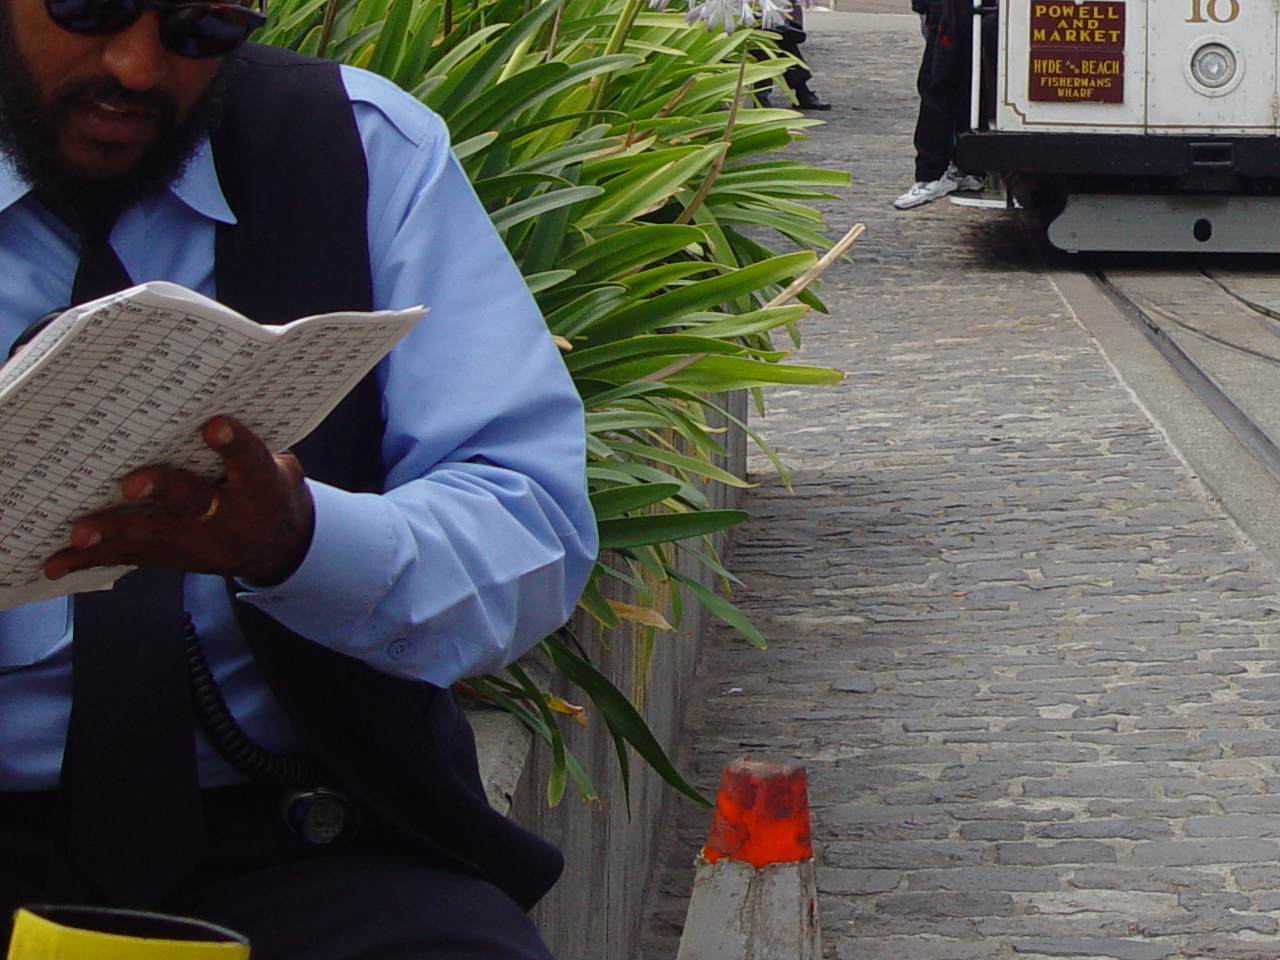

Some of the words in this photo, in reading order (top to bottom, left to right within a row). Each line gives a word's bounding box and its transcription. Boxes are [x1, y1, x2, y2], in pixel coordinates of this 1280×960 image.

[1034, 4, 1120, 19] POWELL
[1057, 19, 1100, 30] AND
[1033, 28, 1121, 43] MARKET
[1033, 59, 1063, 74] HYDE
[1081, 60, 1120, 74] BEACH
[1040, 77, 1112, 88] FISHERMANS
[1057, 88, 1096, 98] WHARF
